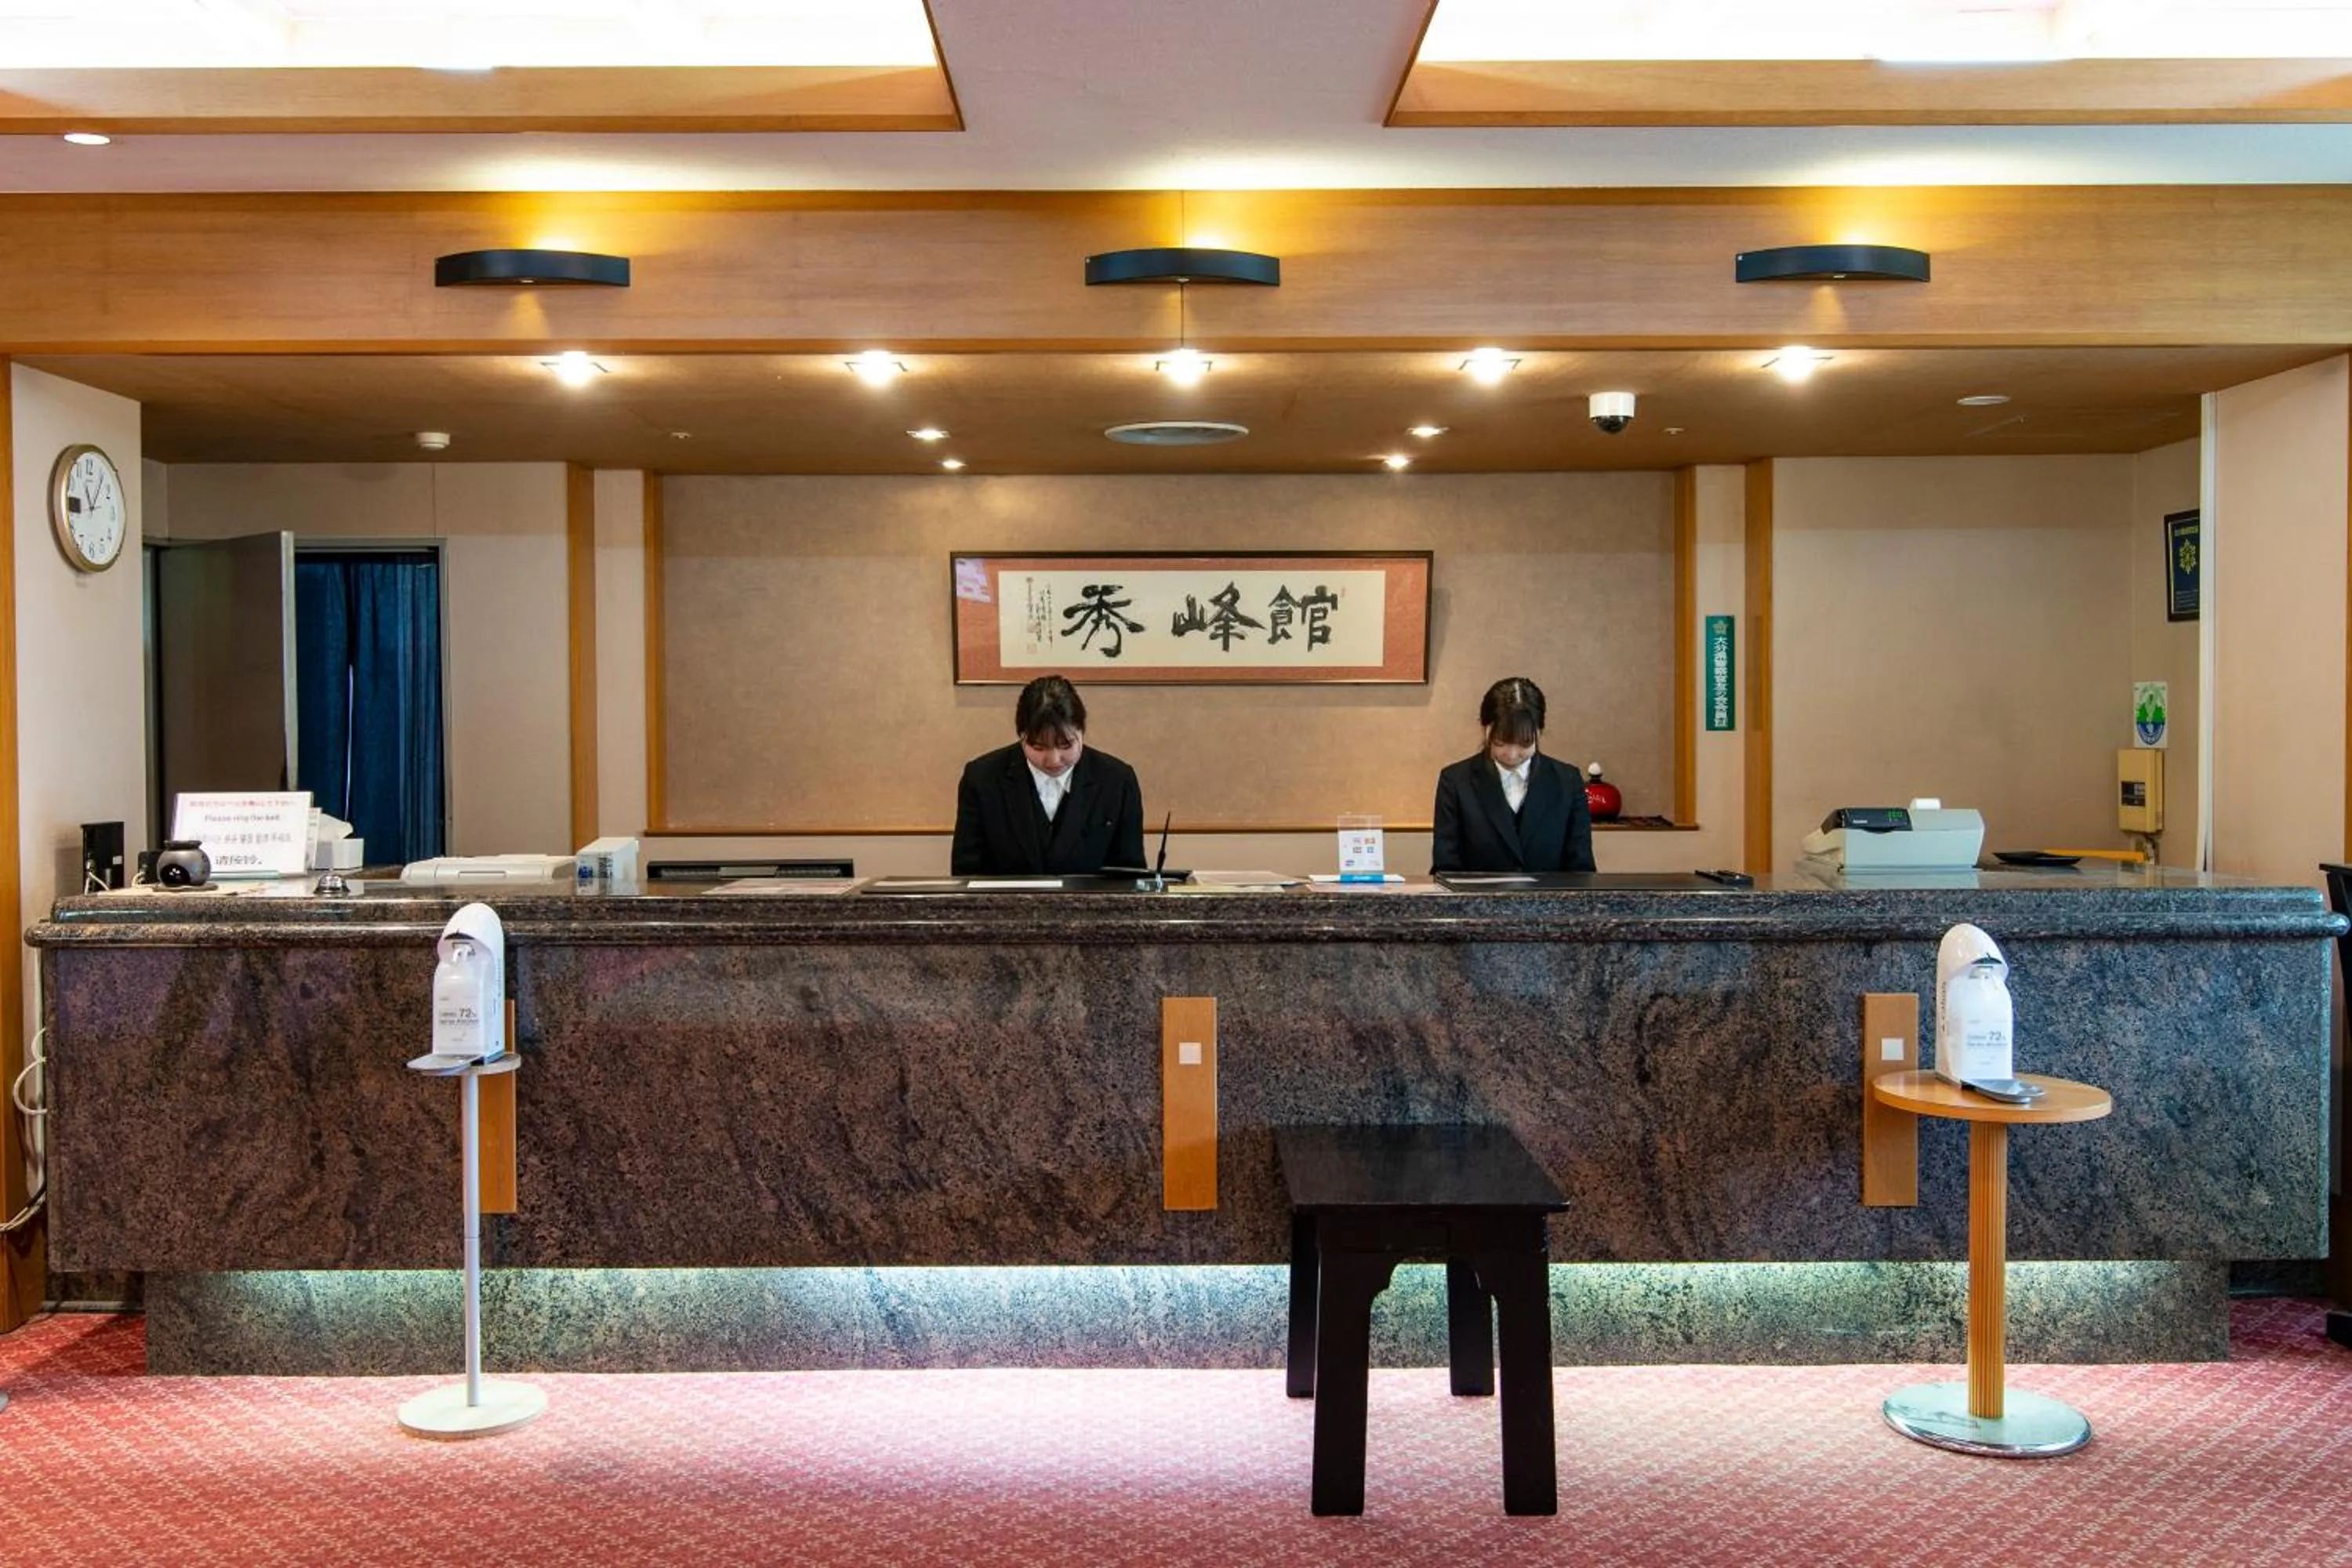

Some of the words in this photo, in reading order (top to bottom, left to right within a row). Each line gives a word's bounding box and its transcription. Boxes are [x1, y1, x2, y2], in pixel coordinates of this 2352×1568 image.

[85, 458, 93, 476] 12
[1060, 580, 1338, 658] 秀峰館
